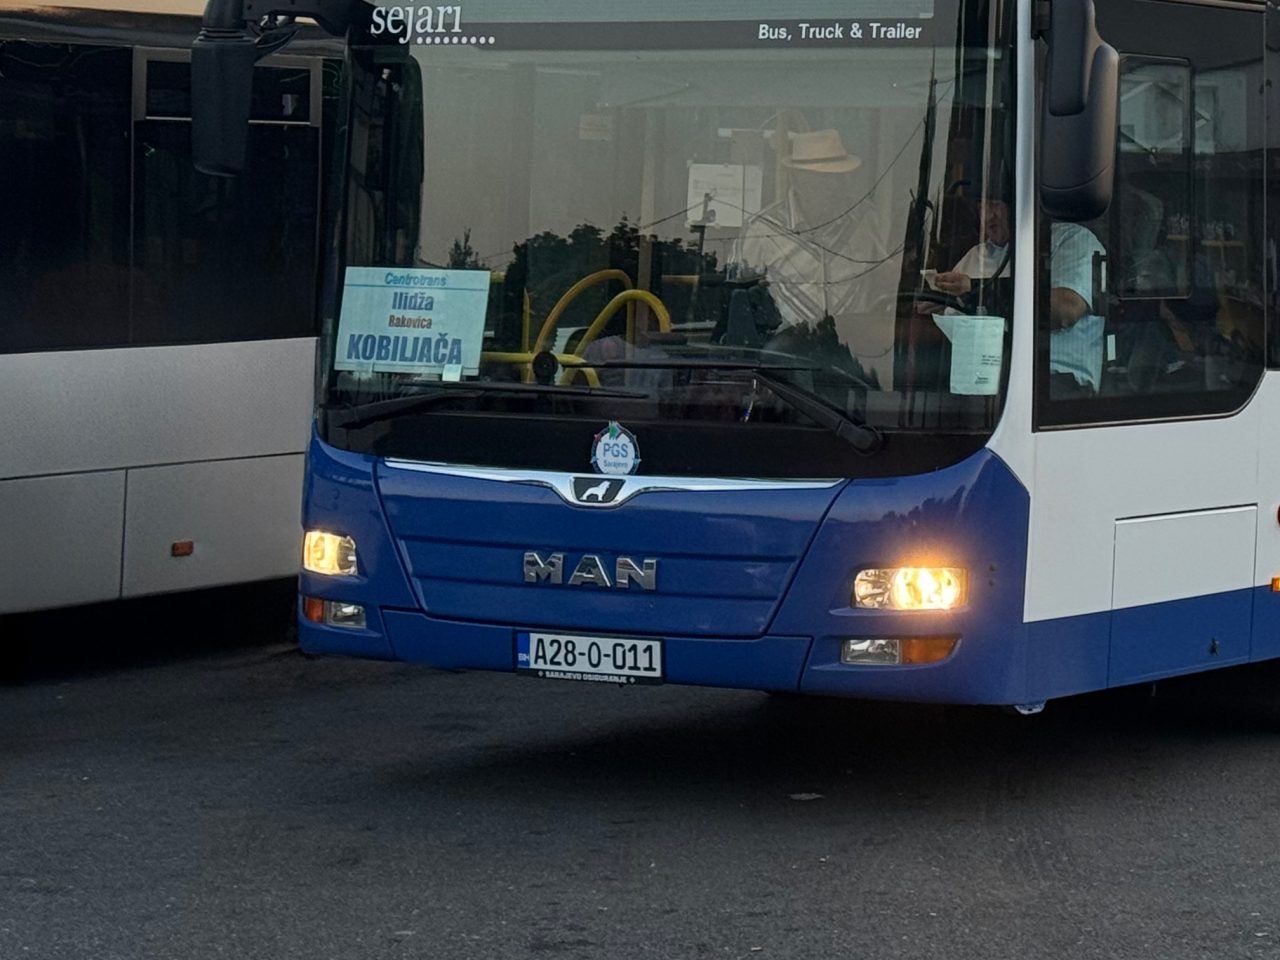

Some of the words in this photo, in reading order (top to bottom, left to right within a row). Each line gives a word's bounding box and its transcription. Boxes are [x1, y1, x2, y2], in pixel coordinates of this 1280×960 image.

[758, 23, 792, 40] Bus,
[798, 22, 843, 39] Truck
[850, 22, 862, 39] &
[869, 22, 922, 39] Trailer
[384, 272, 447, 287] Centrotrans
[391, 291, 434, 311] Ilidža
[388, 314, 432, 330] Rakovica
[347, 332, 462, 365] KOBILJAČA
[602, 442, 629, 458] PGS
[603, 459, 628, 470] Sarajevo
[523, 551, 657, 591] MAN
[545, 670, 582, 681] SARAJEVO
